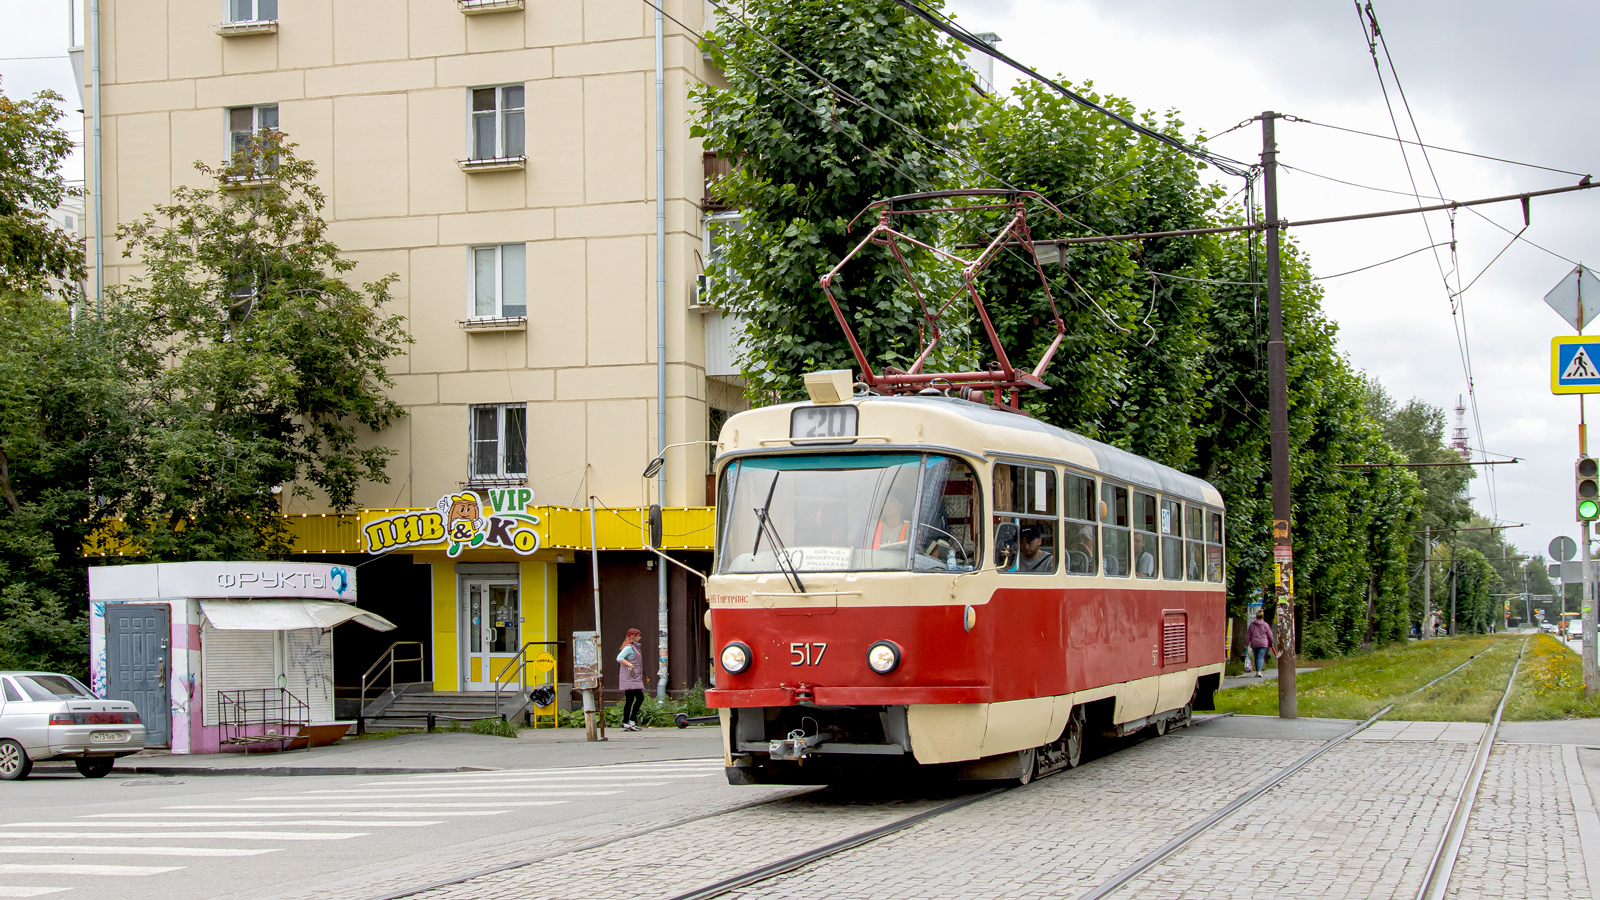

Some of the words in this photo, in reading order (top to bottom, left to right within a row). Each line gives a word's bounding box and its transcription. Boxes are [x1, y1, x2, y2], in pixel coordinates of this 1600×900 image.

[807, 408, 847, 437] 20
[489, 489, 532, 512] VIP
[366, 512, 445, 552] ПИВ
[453, 523, 472, 539] &
[217, 572, 327, 589] ФРУКТЫ
[790, 642, 828, 667] 517
